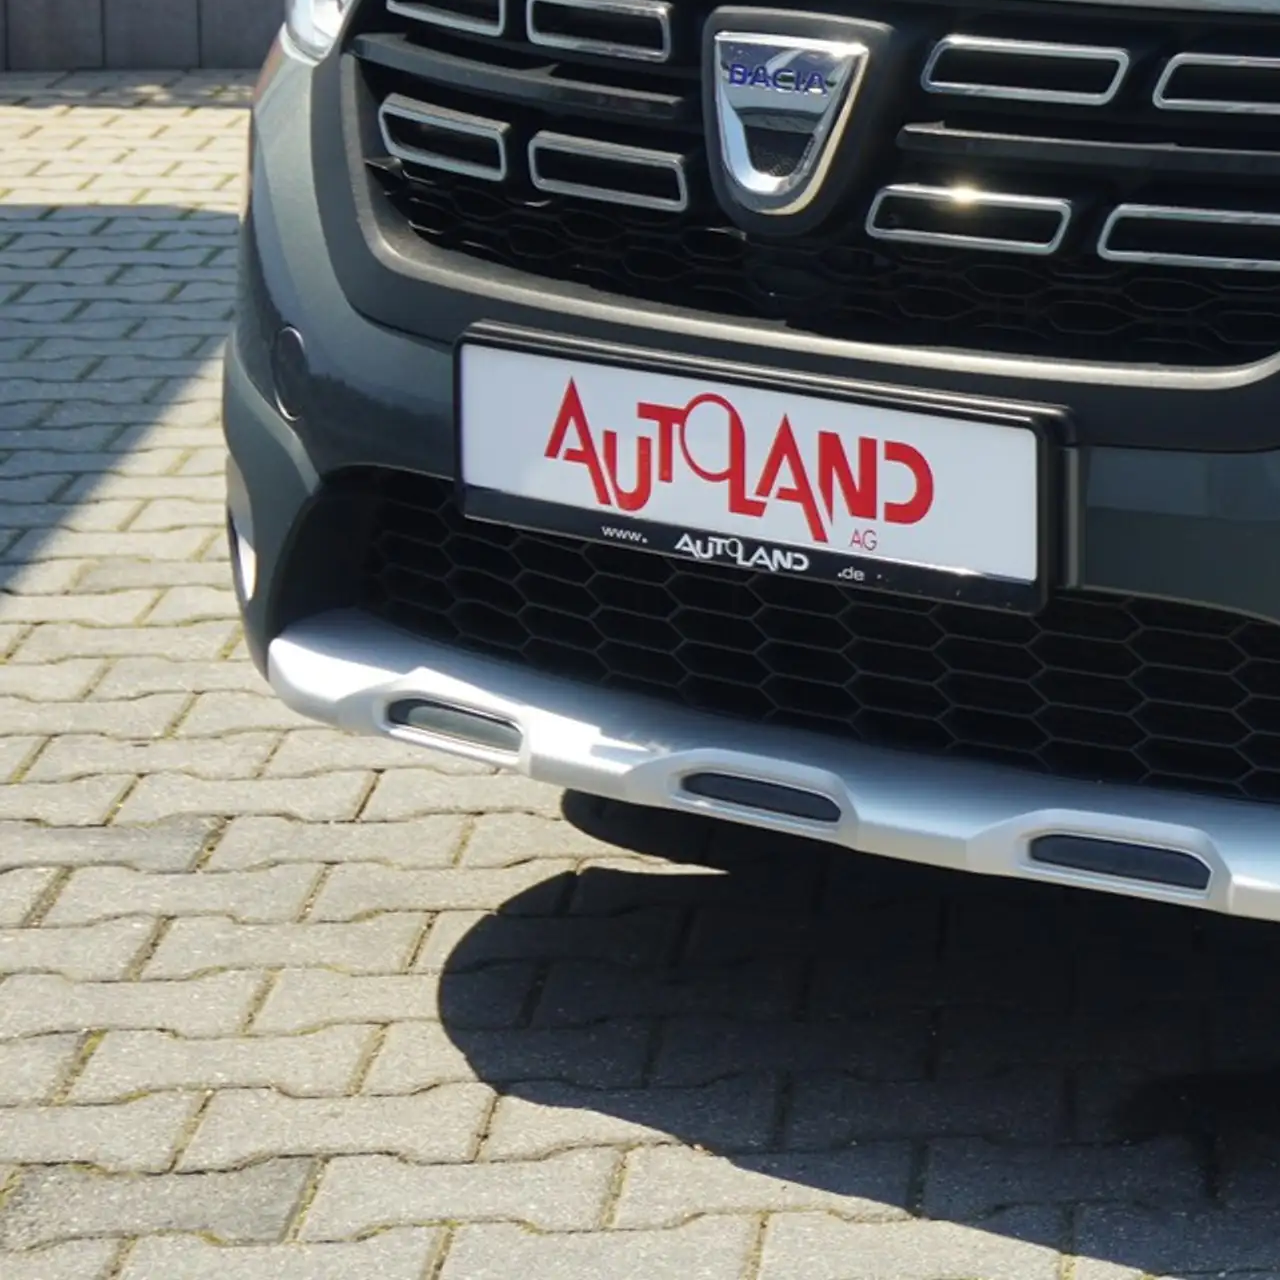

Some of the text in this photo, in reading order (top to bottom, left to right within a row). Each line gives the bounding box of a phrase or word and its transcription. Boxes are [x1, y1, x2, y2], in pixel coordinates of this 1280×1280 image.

[729, 63, 828, 95] DACIA
[544, 377, 934, 542] AUTOLAND
[601, 525, 866, 582] www. AUTOLAND .de
[848, 528, 878, 551] AG
